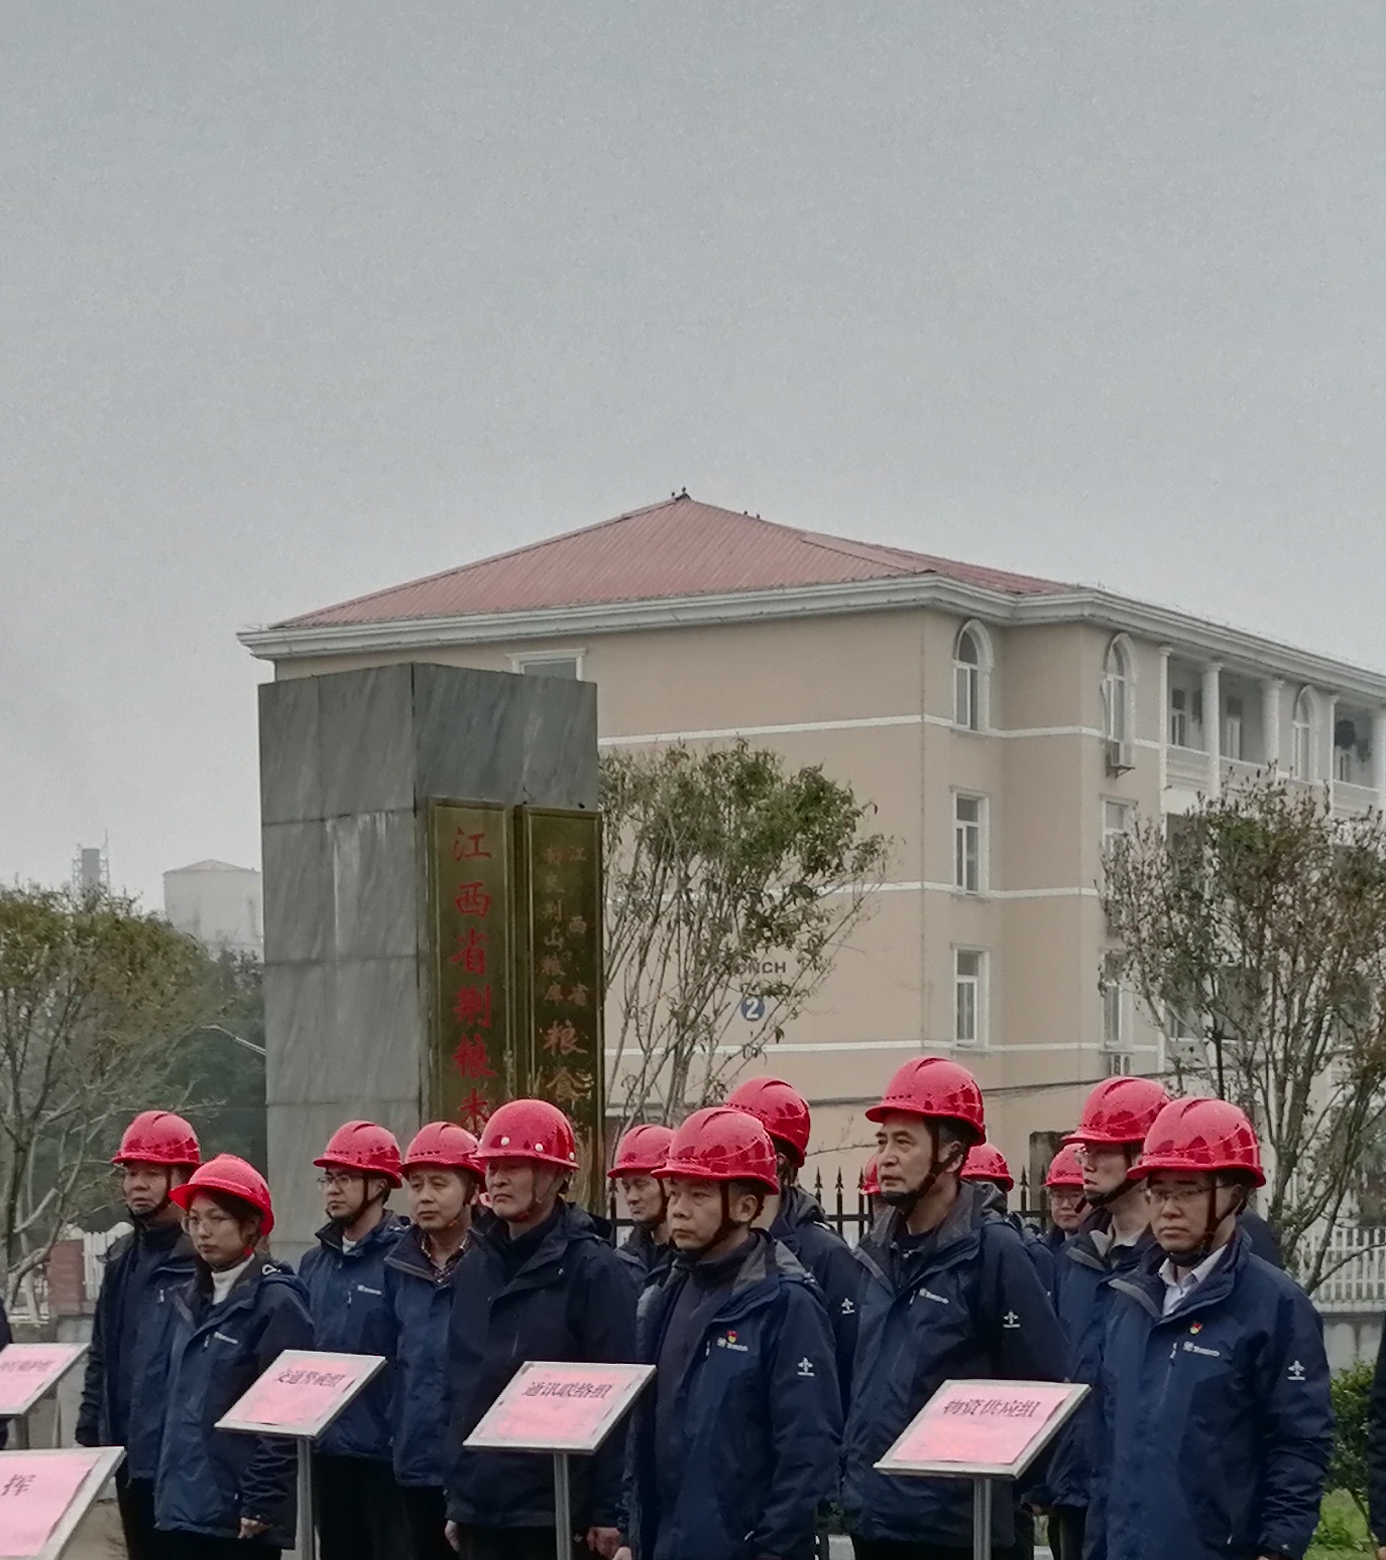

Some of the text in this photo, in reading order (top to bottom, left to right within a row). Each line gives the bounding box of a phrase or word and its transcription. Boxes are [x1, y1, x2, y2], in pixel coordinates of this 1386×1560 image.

[746, 997, 759, 1019] 2
[521, 1379, 614, 1400] 通讯联络组
[942, 1398, 1043, 1418] 物资供应组
